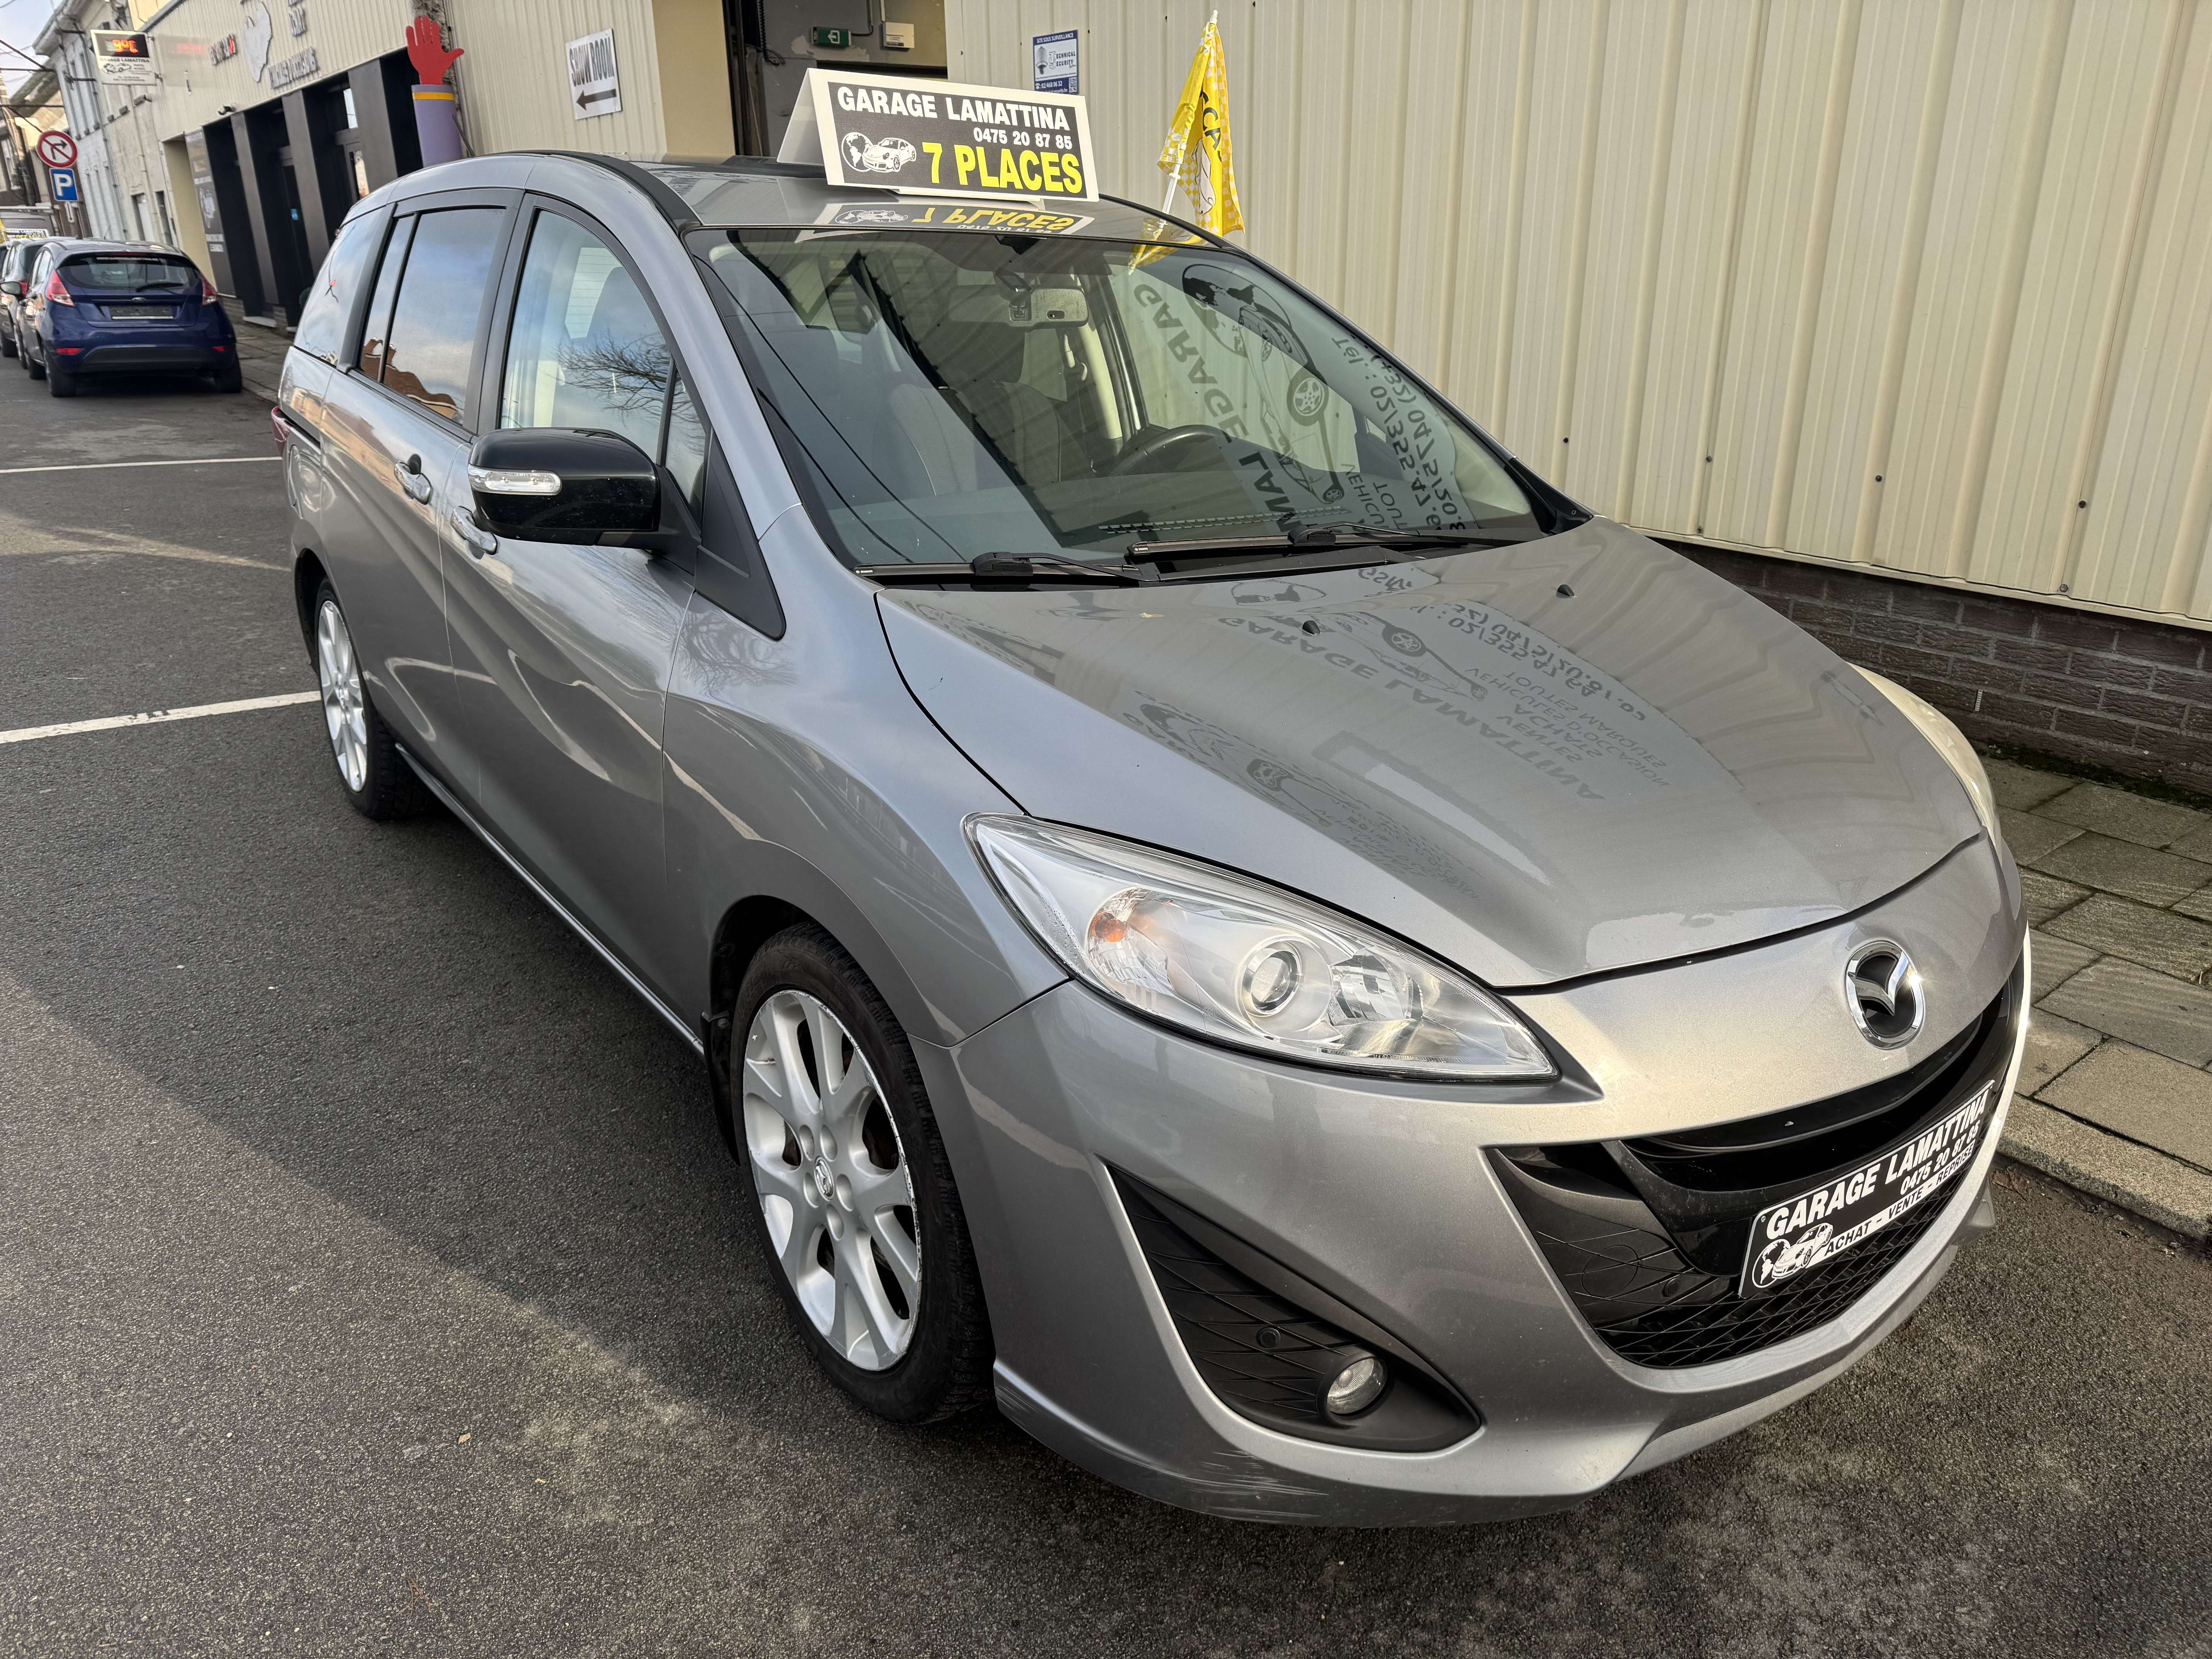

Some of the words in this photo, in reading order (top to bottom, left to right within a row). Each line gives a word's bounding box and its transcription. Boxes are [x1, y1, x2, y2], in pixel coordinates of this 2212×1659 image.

[569, 44, 592, 87] SHOW
[589, 37, 614, 81] ROOM
[837, 86, 938, 118] GARAGE
[945, 97, 1070, 131] LAMATTINA
[973, 127, 1008, 145] 0475
[1012, 130, 1030, 146] 20
[1034, 132, 1050, 148] 87
[1055, 134, 1073, 150] 85
[53, 173, 72, 196] P
[922, 142, 943, 184] 7
[953, 144, 1082, 194] PLACES
[1766, 1163, 1881, 1239] GARAGE
[1885, 1089, 1989, 1185] LAMATTINA
[1900, 1160, 1932, 1195] 0475
[1933, 1147, 1950, 1172] 20
[1951, 1133, 1967, 1157] 87
[1966, 1119, 1980, 1144] 85
[1824, 1221, 1873, 1257] ACHAT
[1888, 1187, 1924, 1219] VENTE
[1936, 1140, 1975, 1185] REPRISE
